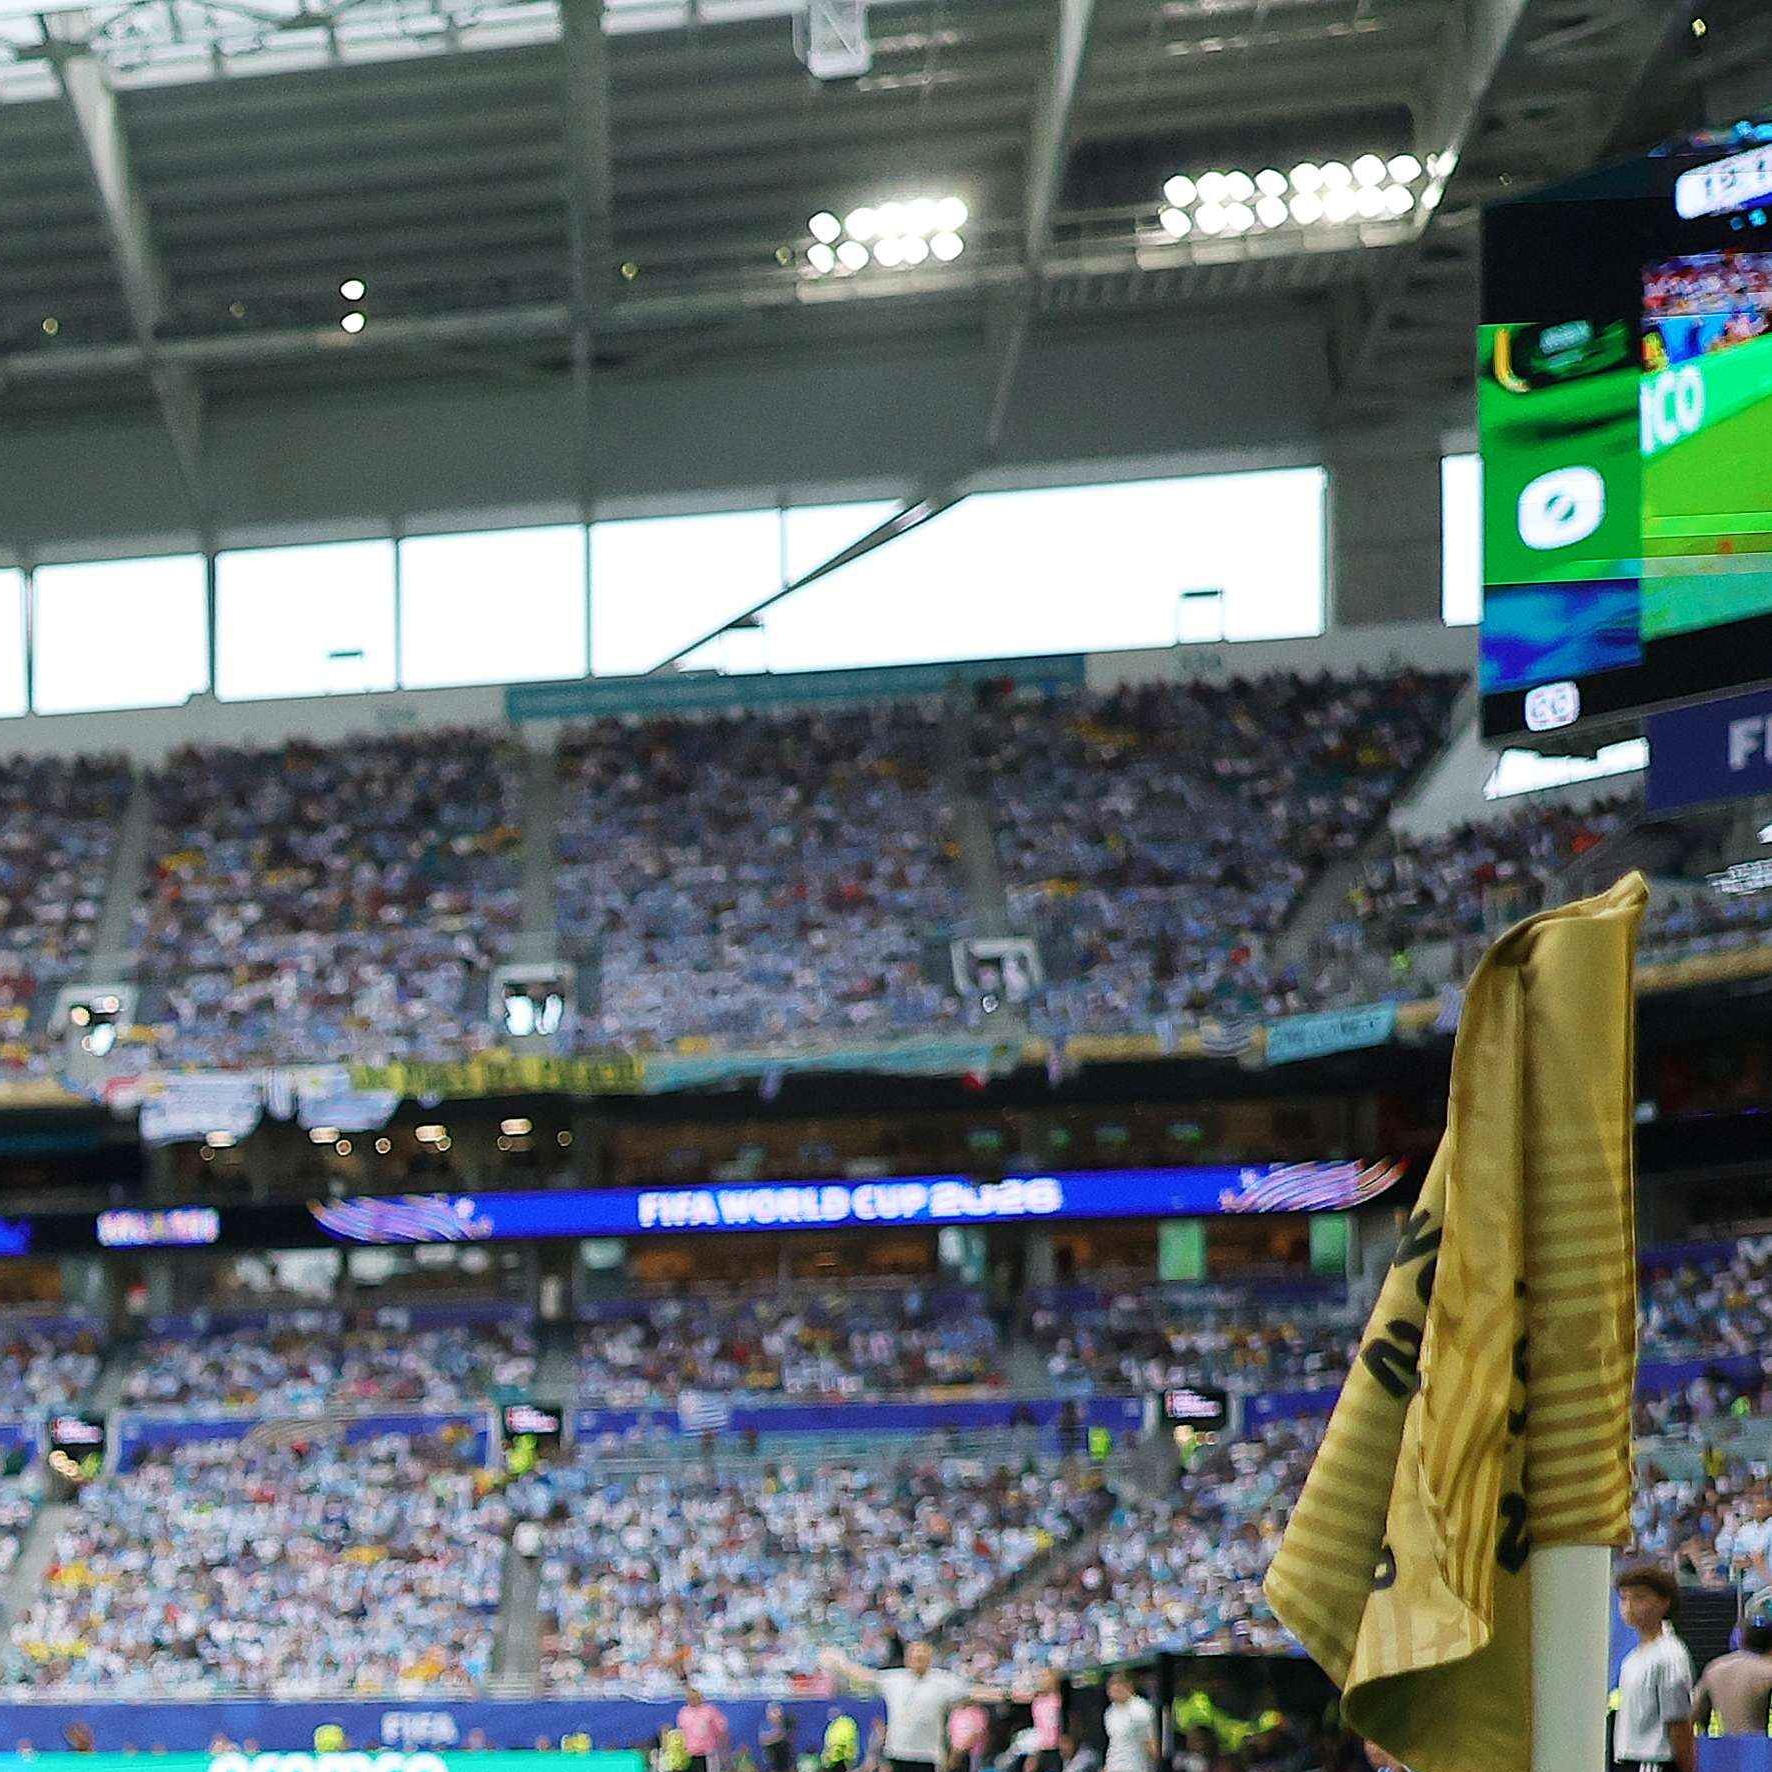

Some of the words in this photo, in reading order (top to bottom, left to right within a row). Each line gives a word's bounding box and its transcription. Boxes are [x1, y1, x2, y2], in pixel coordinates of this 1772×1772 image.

[638, 1189, 719, 1227] FIFA
[717, 1187, 850, 1225] WORLD
[852, 1183, 928, 1220] CUP
